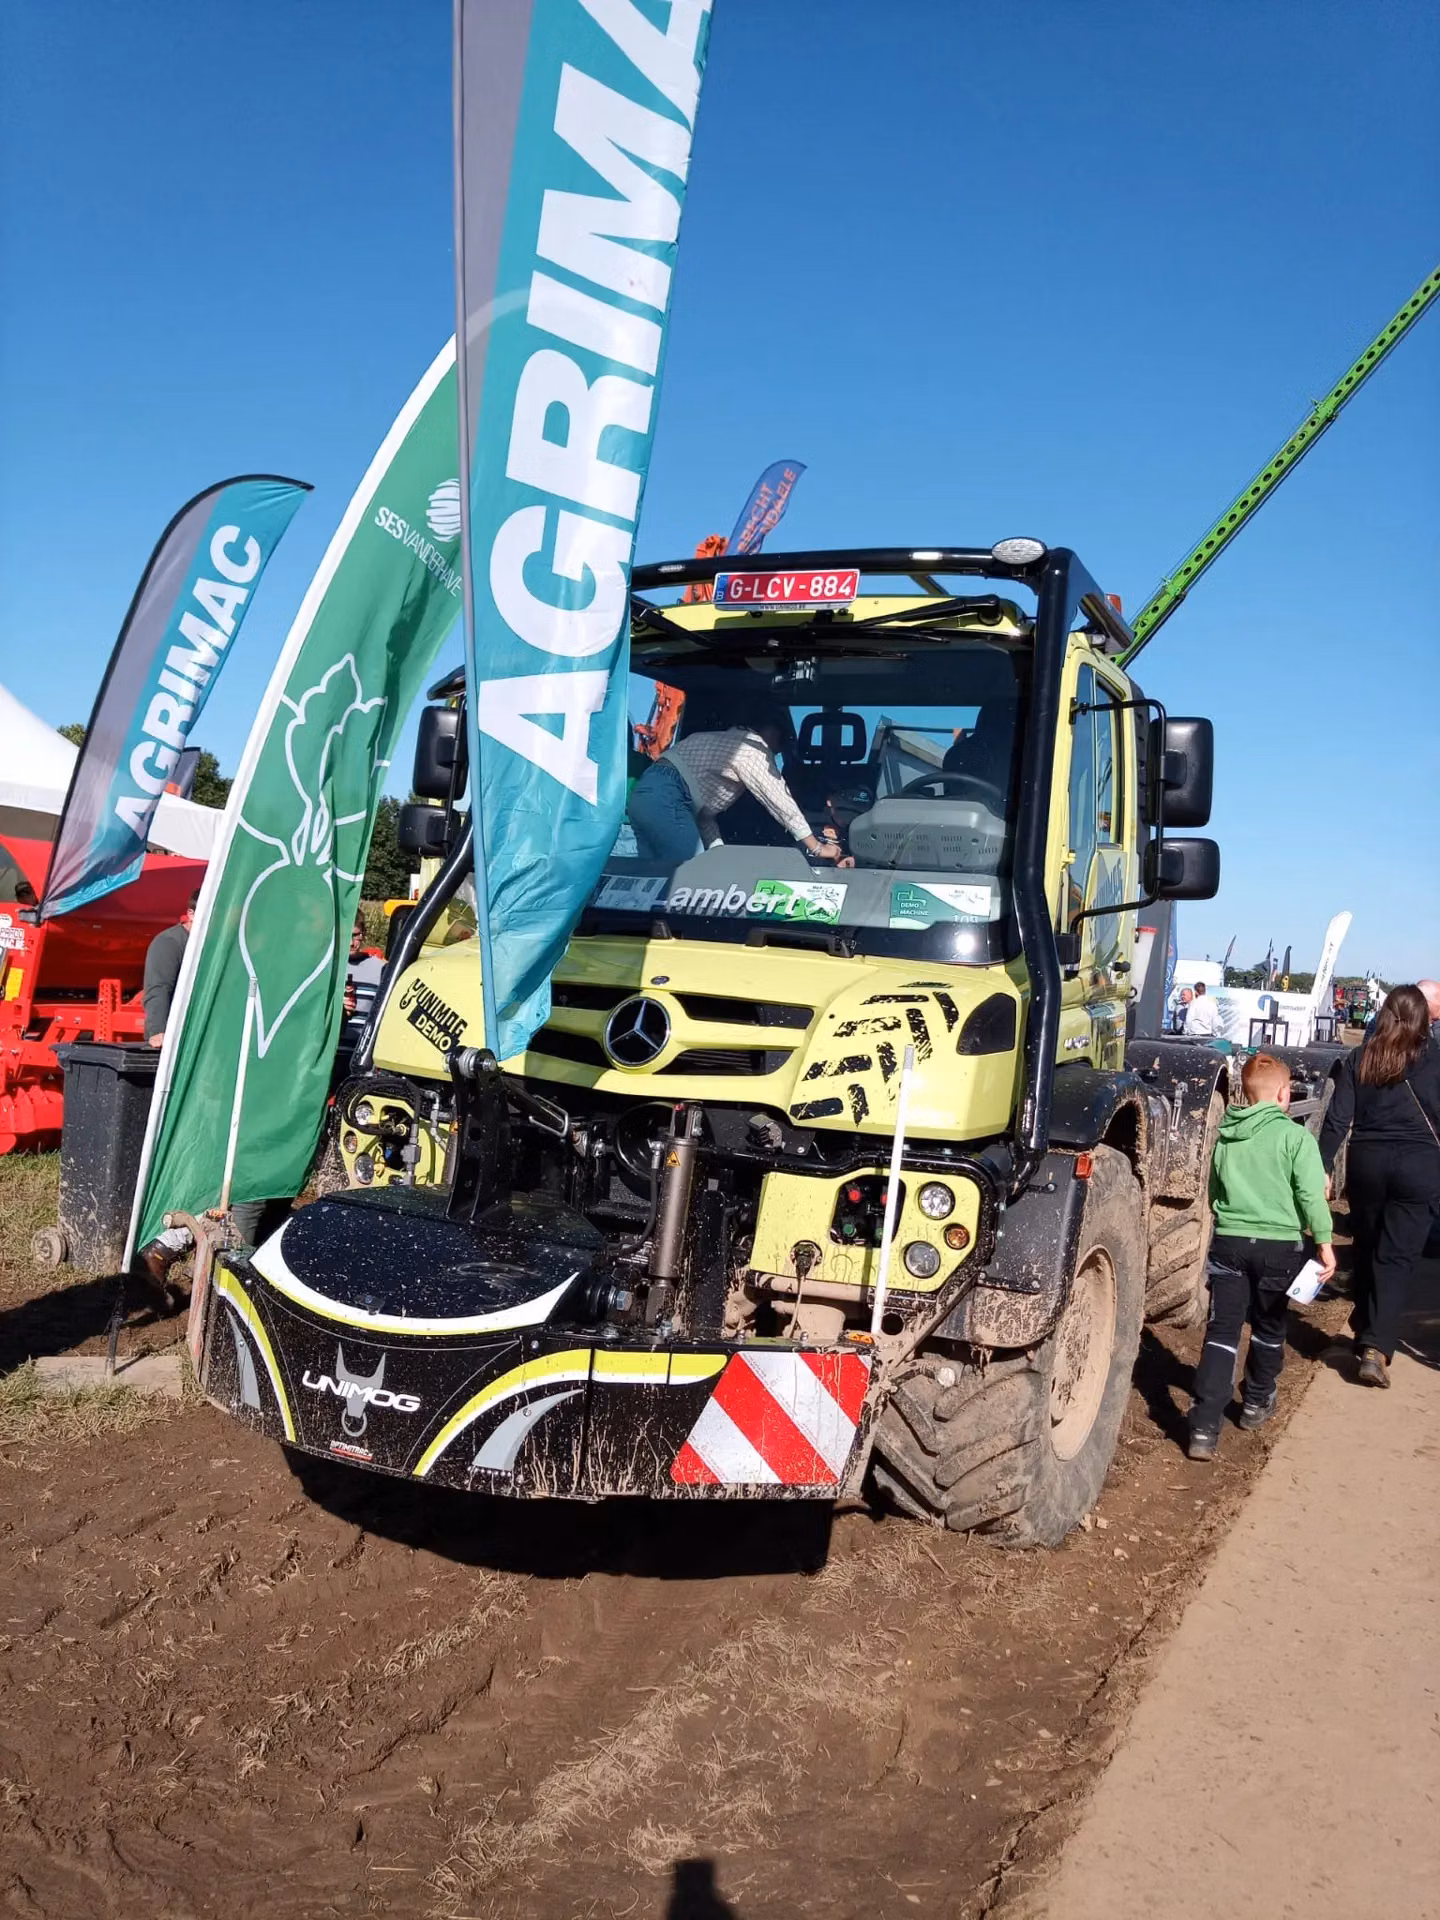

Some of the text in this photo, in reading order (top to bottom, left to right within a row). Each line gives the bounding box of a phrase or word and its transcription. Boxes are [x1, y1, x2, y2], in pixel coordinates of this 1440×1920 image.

[729, 575, 853, 599] G-LCV-884
[114, 525, 261, 840] AGRIMAC
[415, 1014, 452, 1051] DEMO
[302, 1370, 421, 1412] UNIMOG
